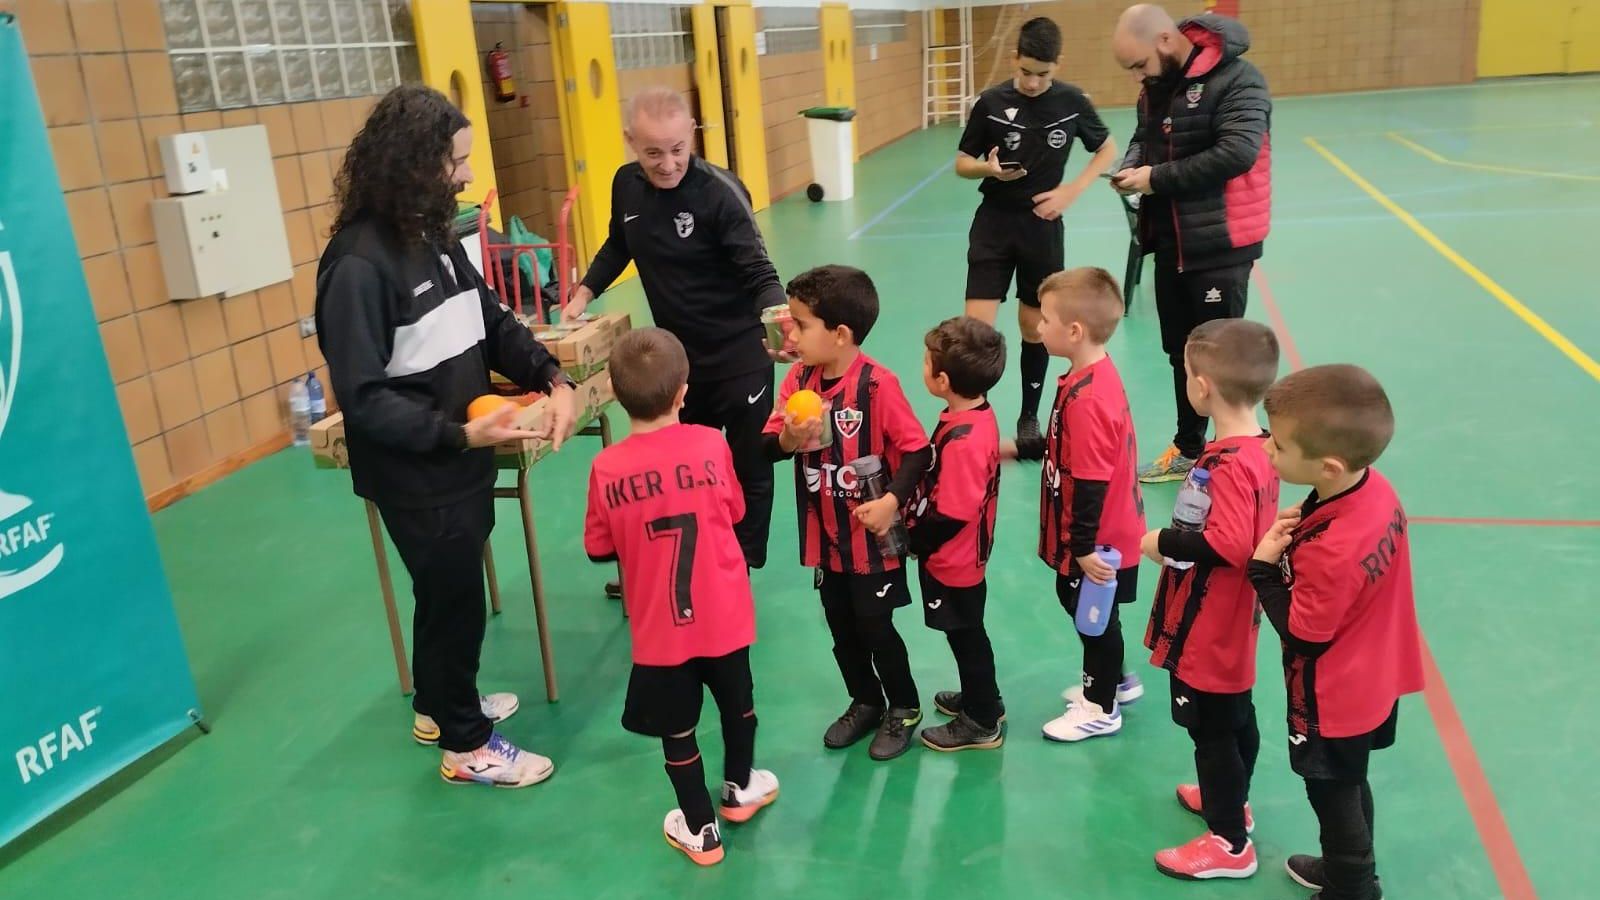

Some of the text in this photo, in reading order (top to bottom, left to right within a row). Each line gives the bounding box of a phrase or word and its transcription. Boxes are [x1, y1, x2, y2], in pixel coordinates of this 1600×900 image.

[605, 470, 664, 509] IKER
[645, 512, 698, 627] 7
[15, 707, 98, 784] RFAF
